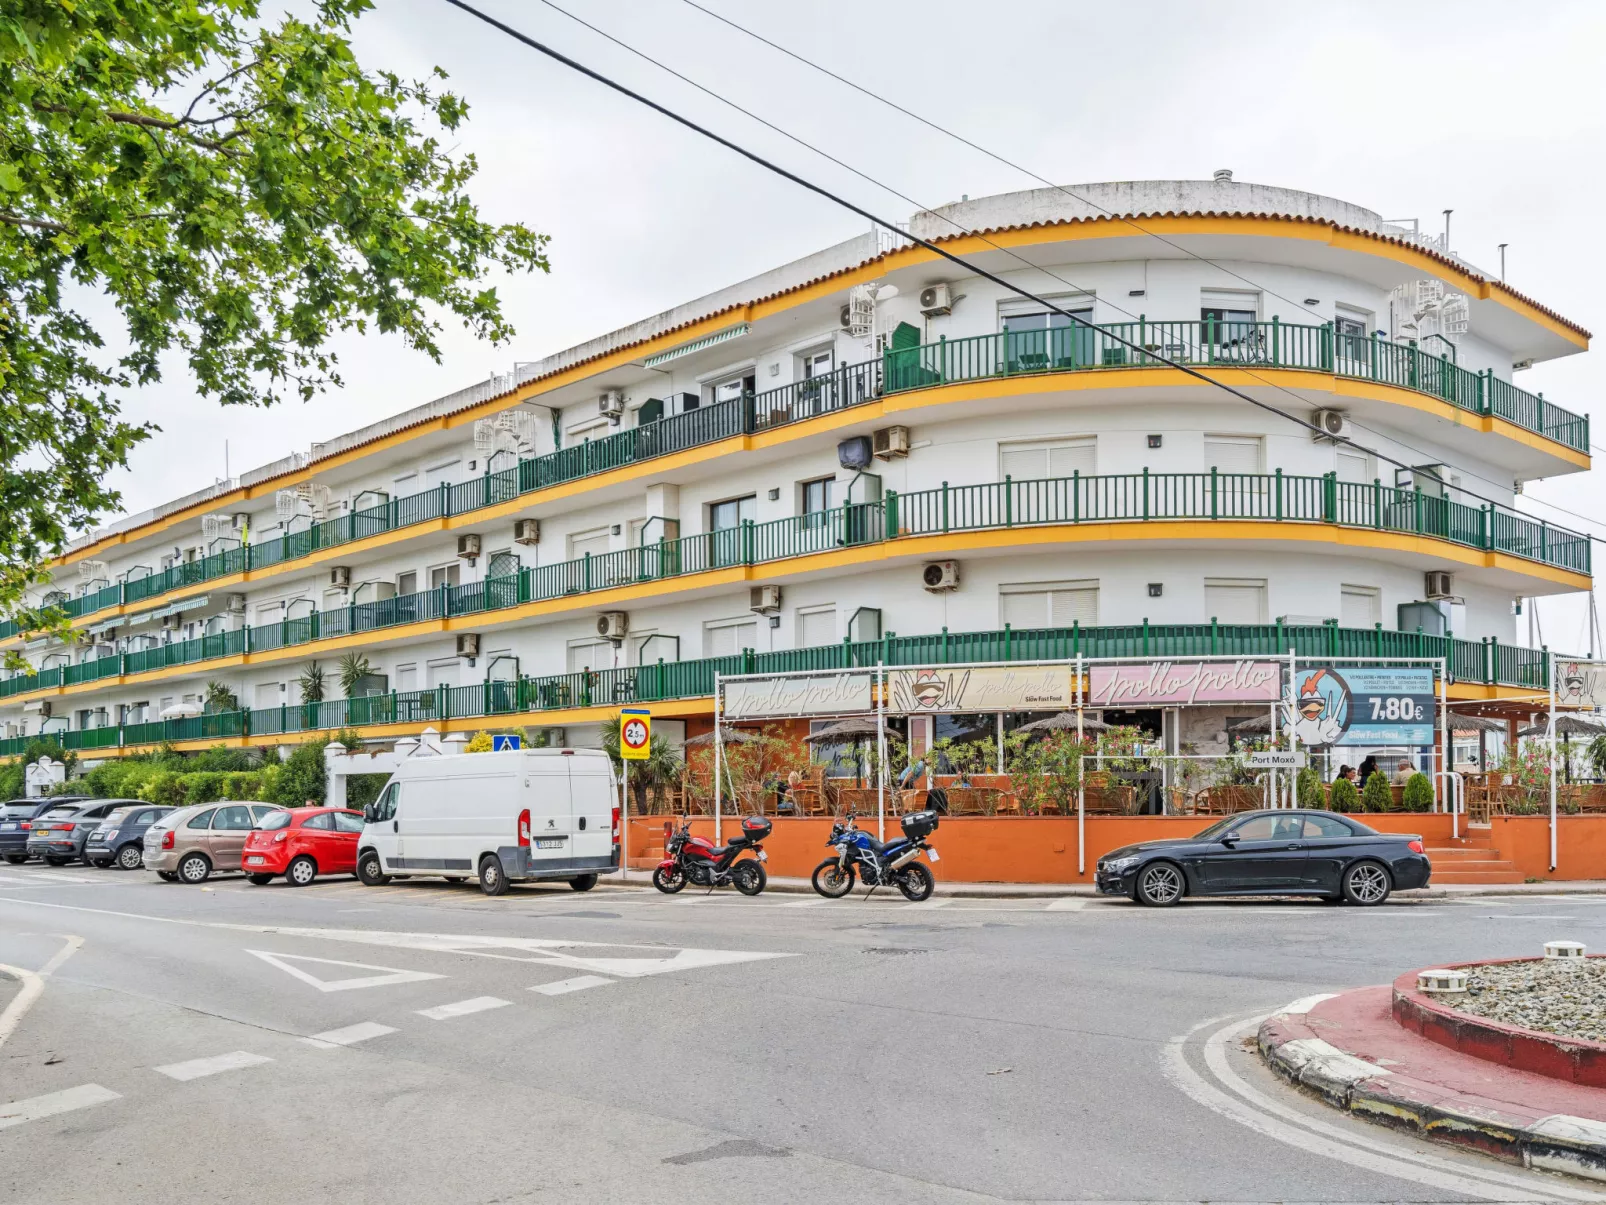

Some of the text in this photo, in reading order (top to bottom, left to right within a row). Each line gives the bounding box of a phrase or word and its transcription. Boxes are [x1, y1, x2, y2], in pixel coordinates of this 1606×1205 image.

[1367, 731, 1381, 739] Fast
[1381, 730, 1399, 739] Food
[1252, 756, 1296, 764] Port Moxó
